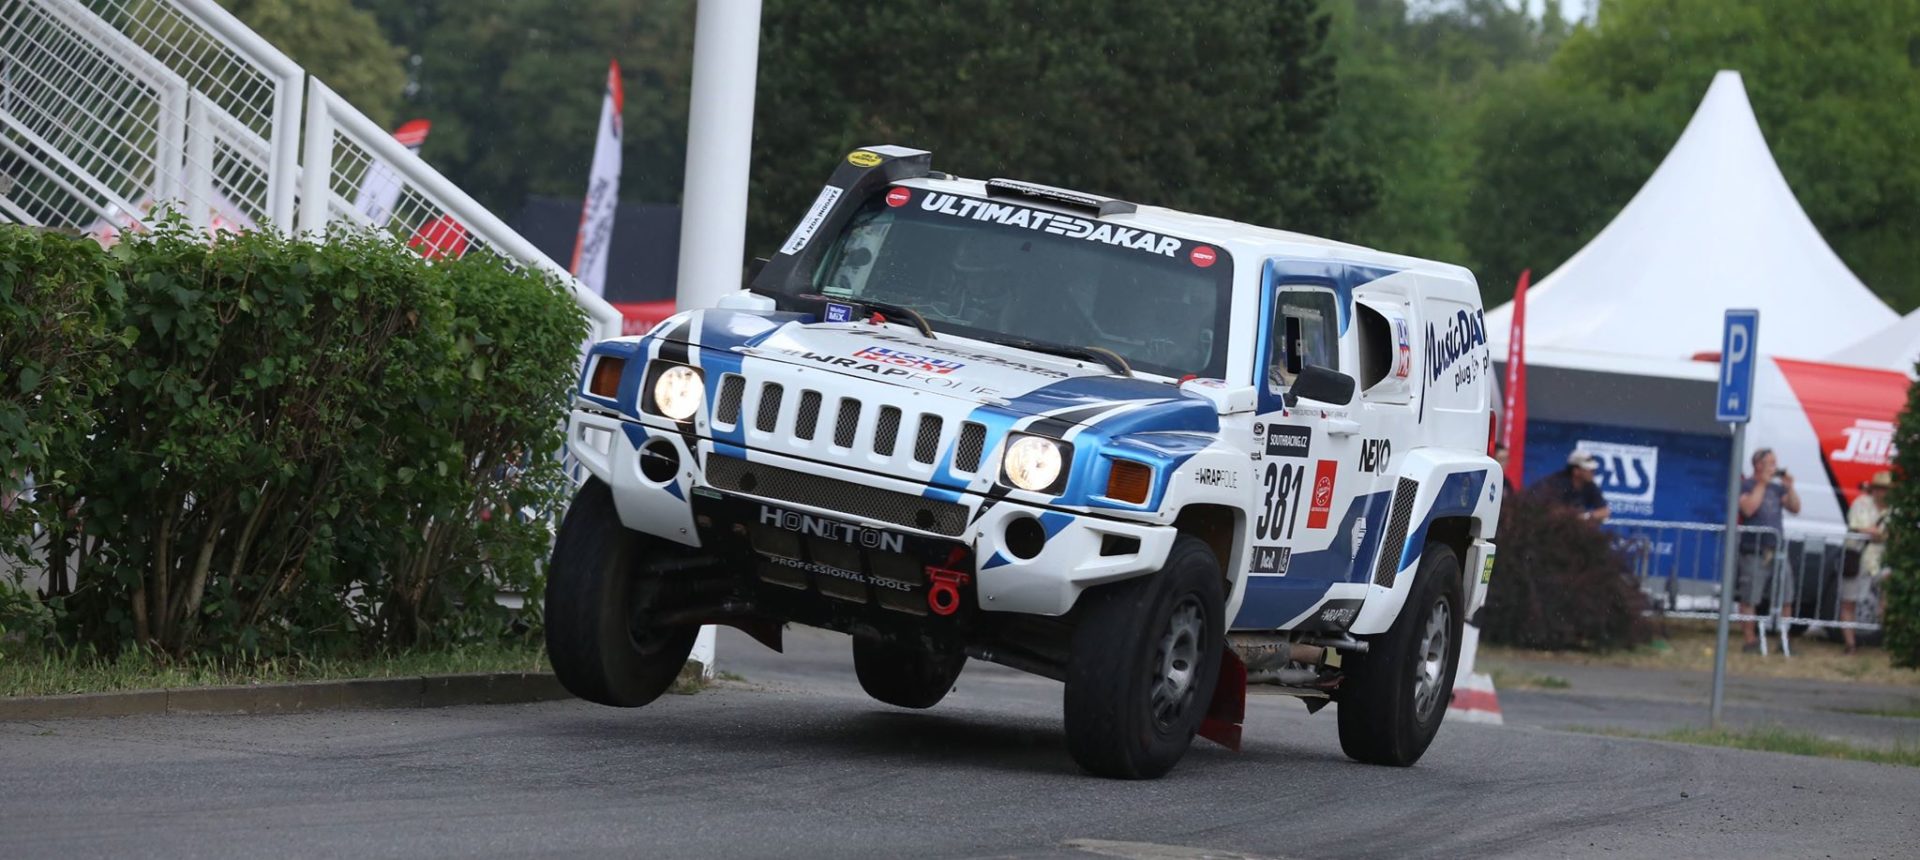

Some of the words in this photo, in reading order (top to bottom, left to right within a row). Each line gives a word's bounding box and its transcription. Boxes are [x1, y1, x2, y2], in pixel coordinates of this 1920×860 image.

[1418, 308, 1487, 425] MusicDAT
[1726, 323, 1748, 387] P
[1269, 433, 1308, 448] SOUTHRACING.CZ
[1358, 438, 1391, 477] NEXO
[1255, 462, 1305, 541] 381
[759, 505, 904, 554] HONITON
[770, 556, 866, 584] PROFESSIONAL
[868, 575, 912, 592] TOOLS
